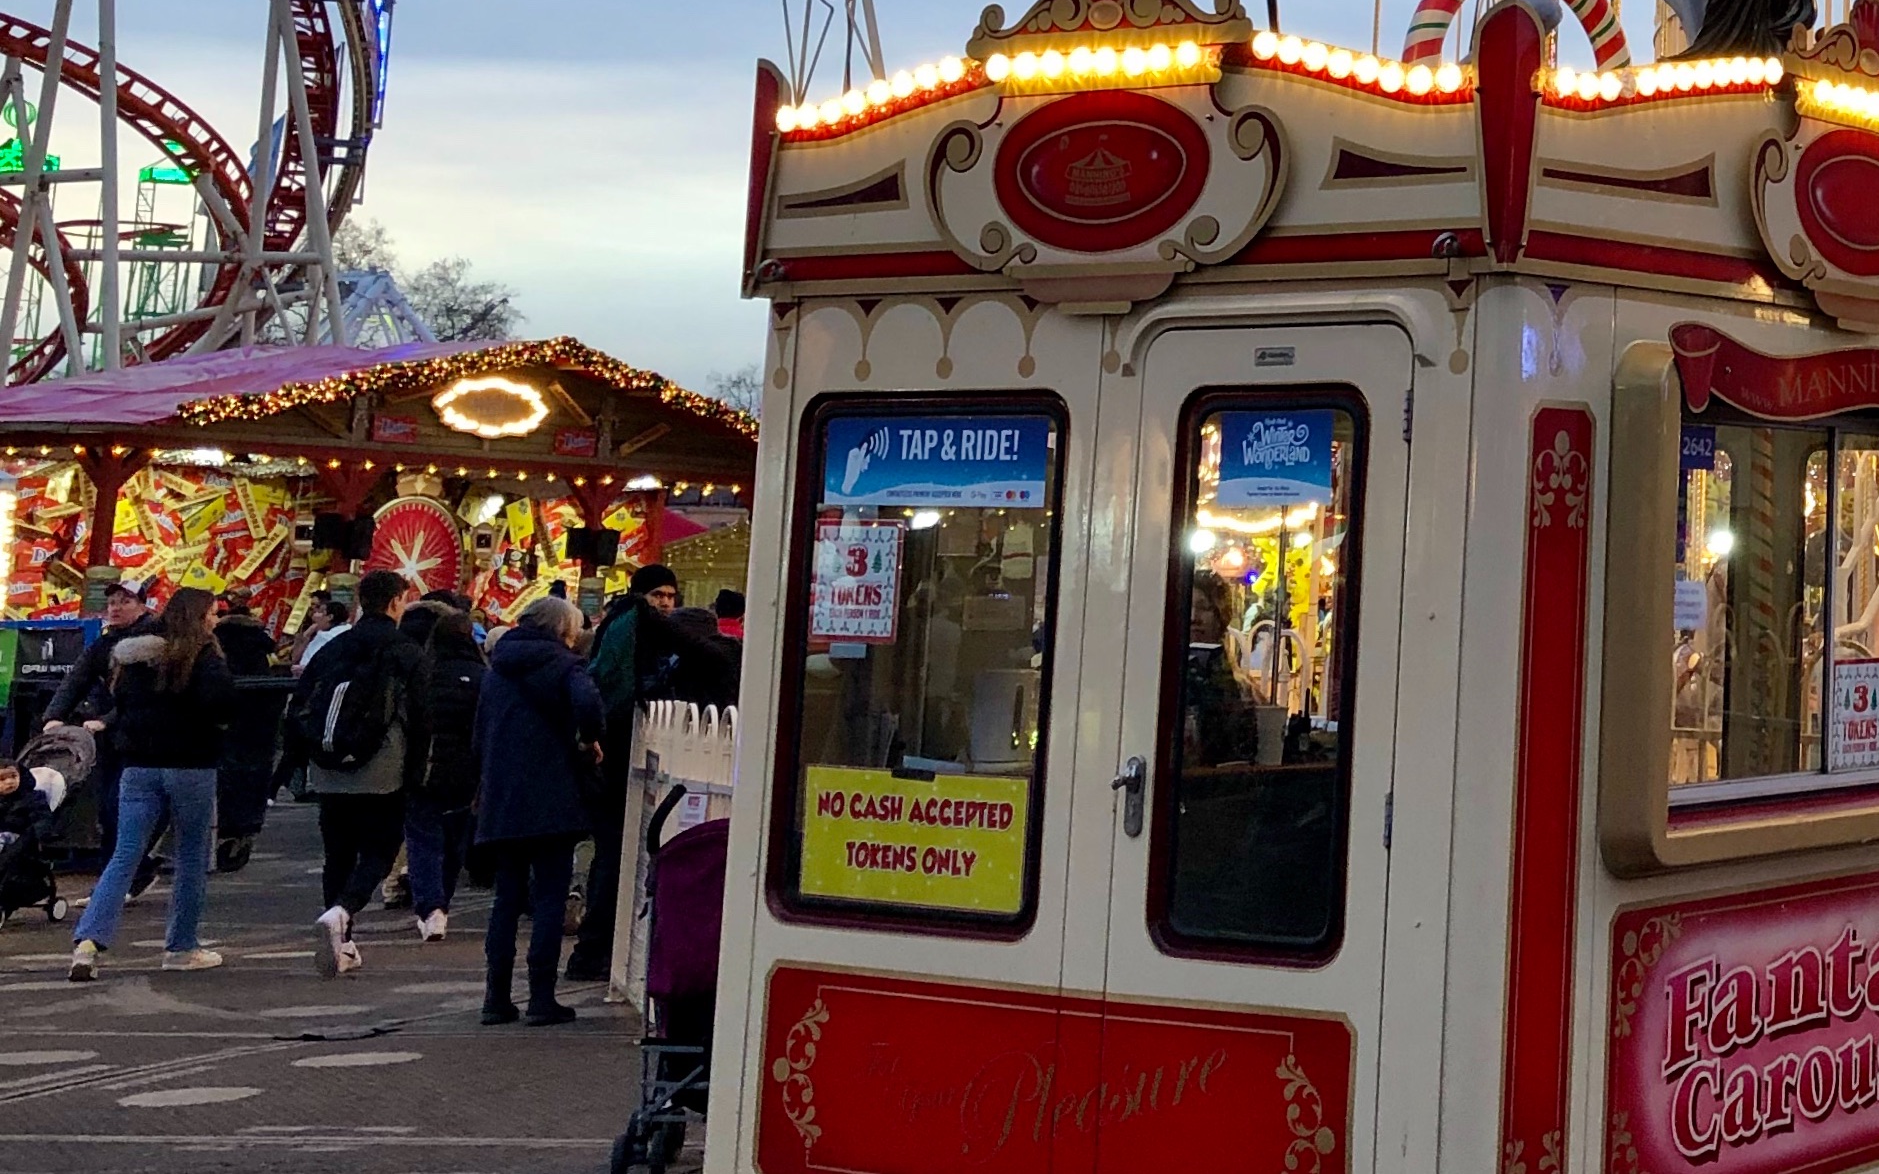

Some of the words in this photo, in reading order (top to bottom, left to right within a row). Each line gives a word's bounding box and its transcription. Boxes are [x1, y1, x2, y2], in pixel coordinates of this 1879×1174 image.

[899, 429, 939, 461] TAP
[941, 429, 957, 461] &
[961, 429, 1021, 461] RIDE!
[1683, 437, 1713, 457] 2642
[846, 544, 868, 577] 3
[831, 584, 882, 606] TOKENS
[1853, 685, 1869, 713] 3
[1843, 718, 1878, 741] TOKENS
[817, 791, 845, 818] NO
[850, 793, 904, 821] CASH
[908, 798, 1014, 830] ACCEPTED
[846, 841, 917, 873] TOKENS
[922, 847, 977, 877] ONLY
